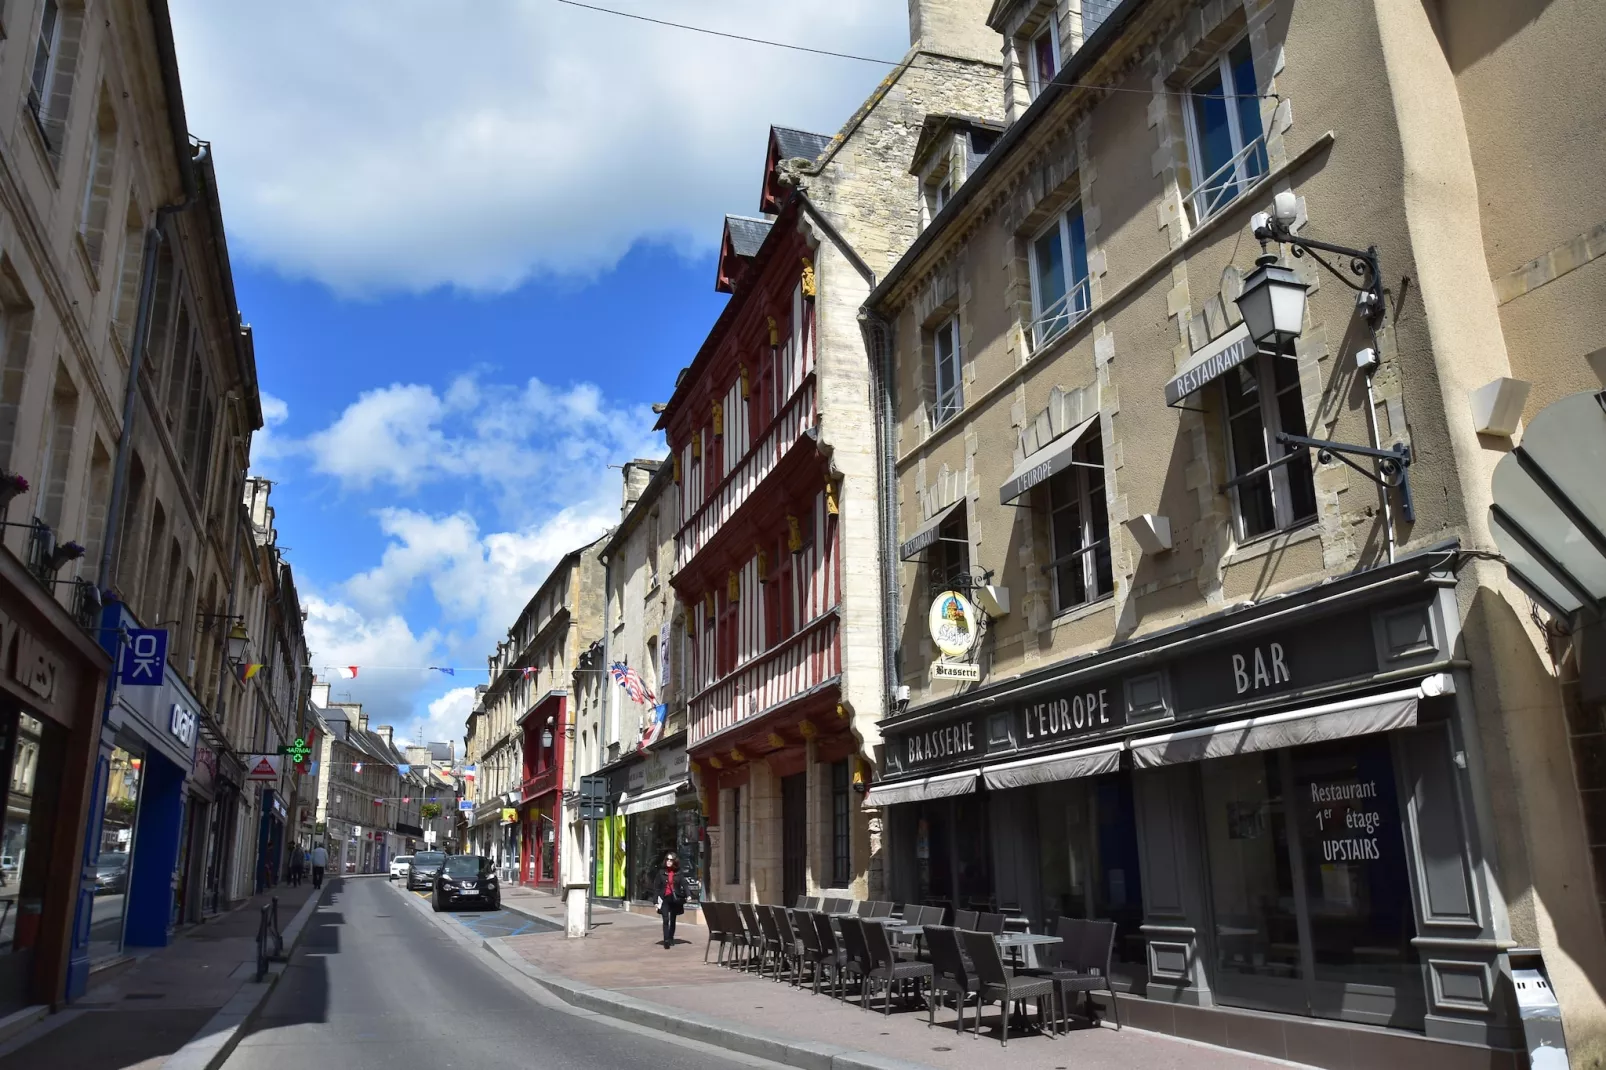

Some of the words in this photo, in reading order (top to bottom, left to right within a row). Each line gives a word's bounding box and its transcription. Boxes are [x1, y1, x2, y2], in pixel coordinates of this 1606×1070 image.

[1177, 339, 1246, 398] RESTAURANT
[1016, 460, 1053, 494] L'EUROPE
[937, 623, 971, 646] Leffe
[935, 665, 977, 678] Brasserie
[1232, 642, 1290, 694] BAR
[908, 721, 975, 763] BRASSERIE
[1025, 689, 1110, 739] L'EUROPE
[1311, 780, 1377, 803] Restaurant
[1316, 808, 1333, 831] 1er
[1346, 807, 1380, 834] étage
[1323, 838, 1380, 861] UPSTAIRS
